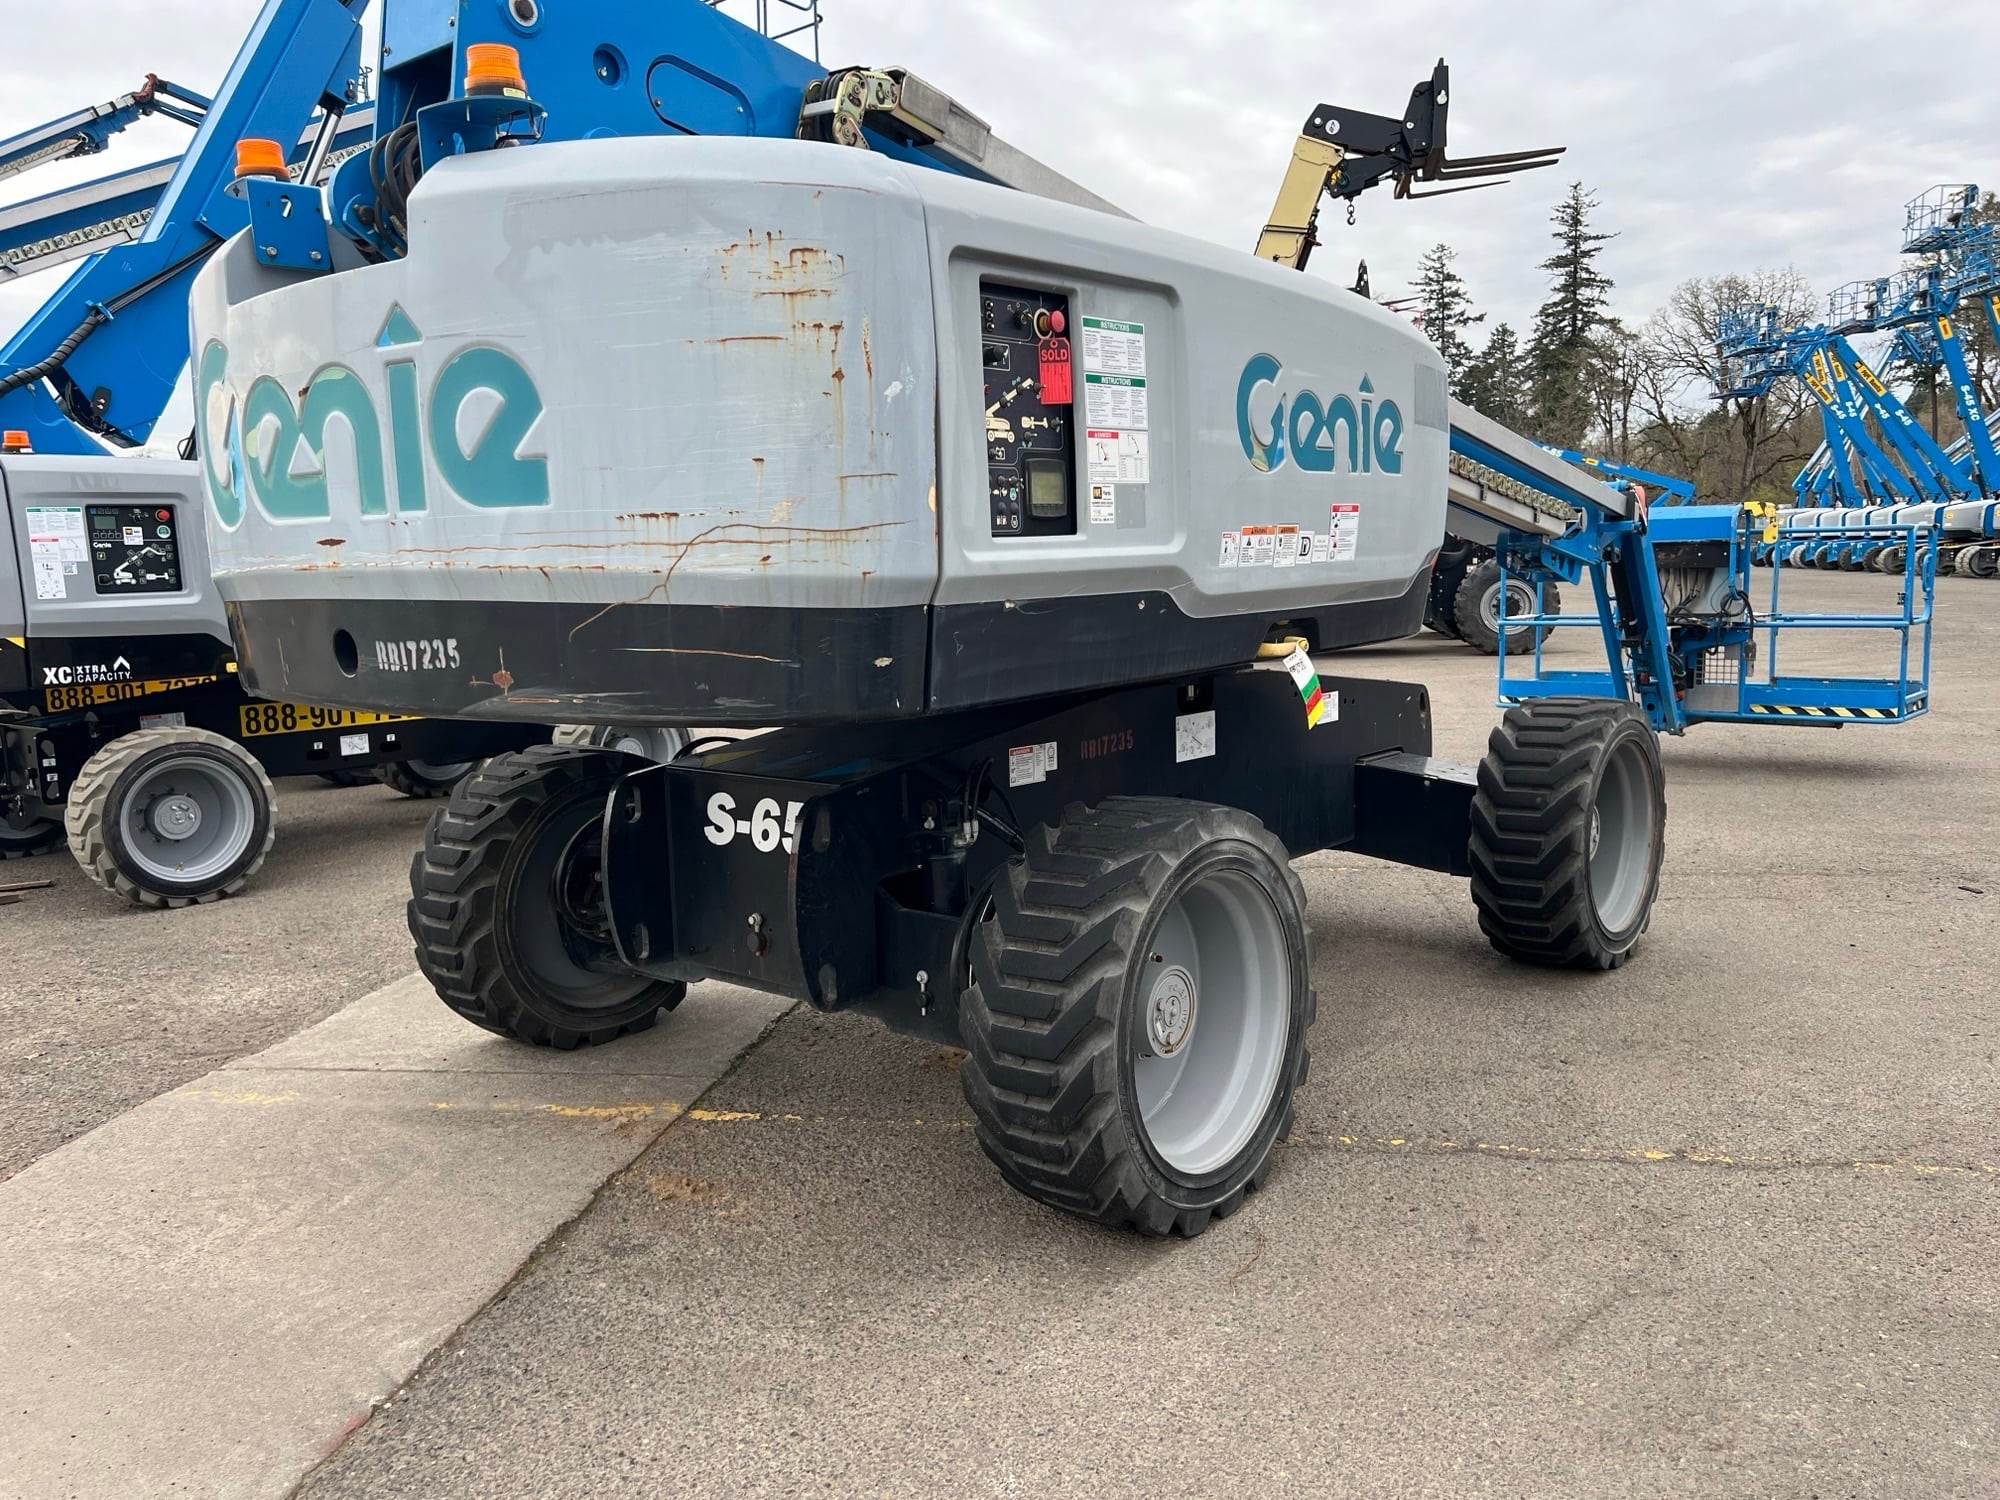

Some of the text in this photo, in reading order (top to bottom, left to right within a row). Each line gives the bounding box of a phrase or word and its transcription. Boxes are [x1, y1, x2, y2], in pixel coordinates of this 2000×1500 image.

[1100, 321, 1130, 332] INSTRUCTIONS
[1041, 349, 1068, 361] SOLD
[1101, 377, 1132, 386] INSTRUCTIONS
[199, 300, 552, 532] Genie
[1236, 353, 1404, 475] Genie
[1830, 404, 1847, 419] S-45
[1874, 402, 1891, 419] S-45
[1894, 409, 1913, 426] S-45
[1967, 407, 1980, 421] XC
[43, 664, 107, 685] XC XTRA
[77, 671, 131, 683] CAPACITY
